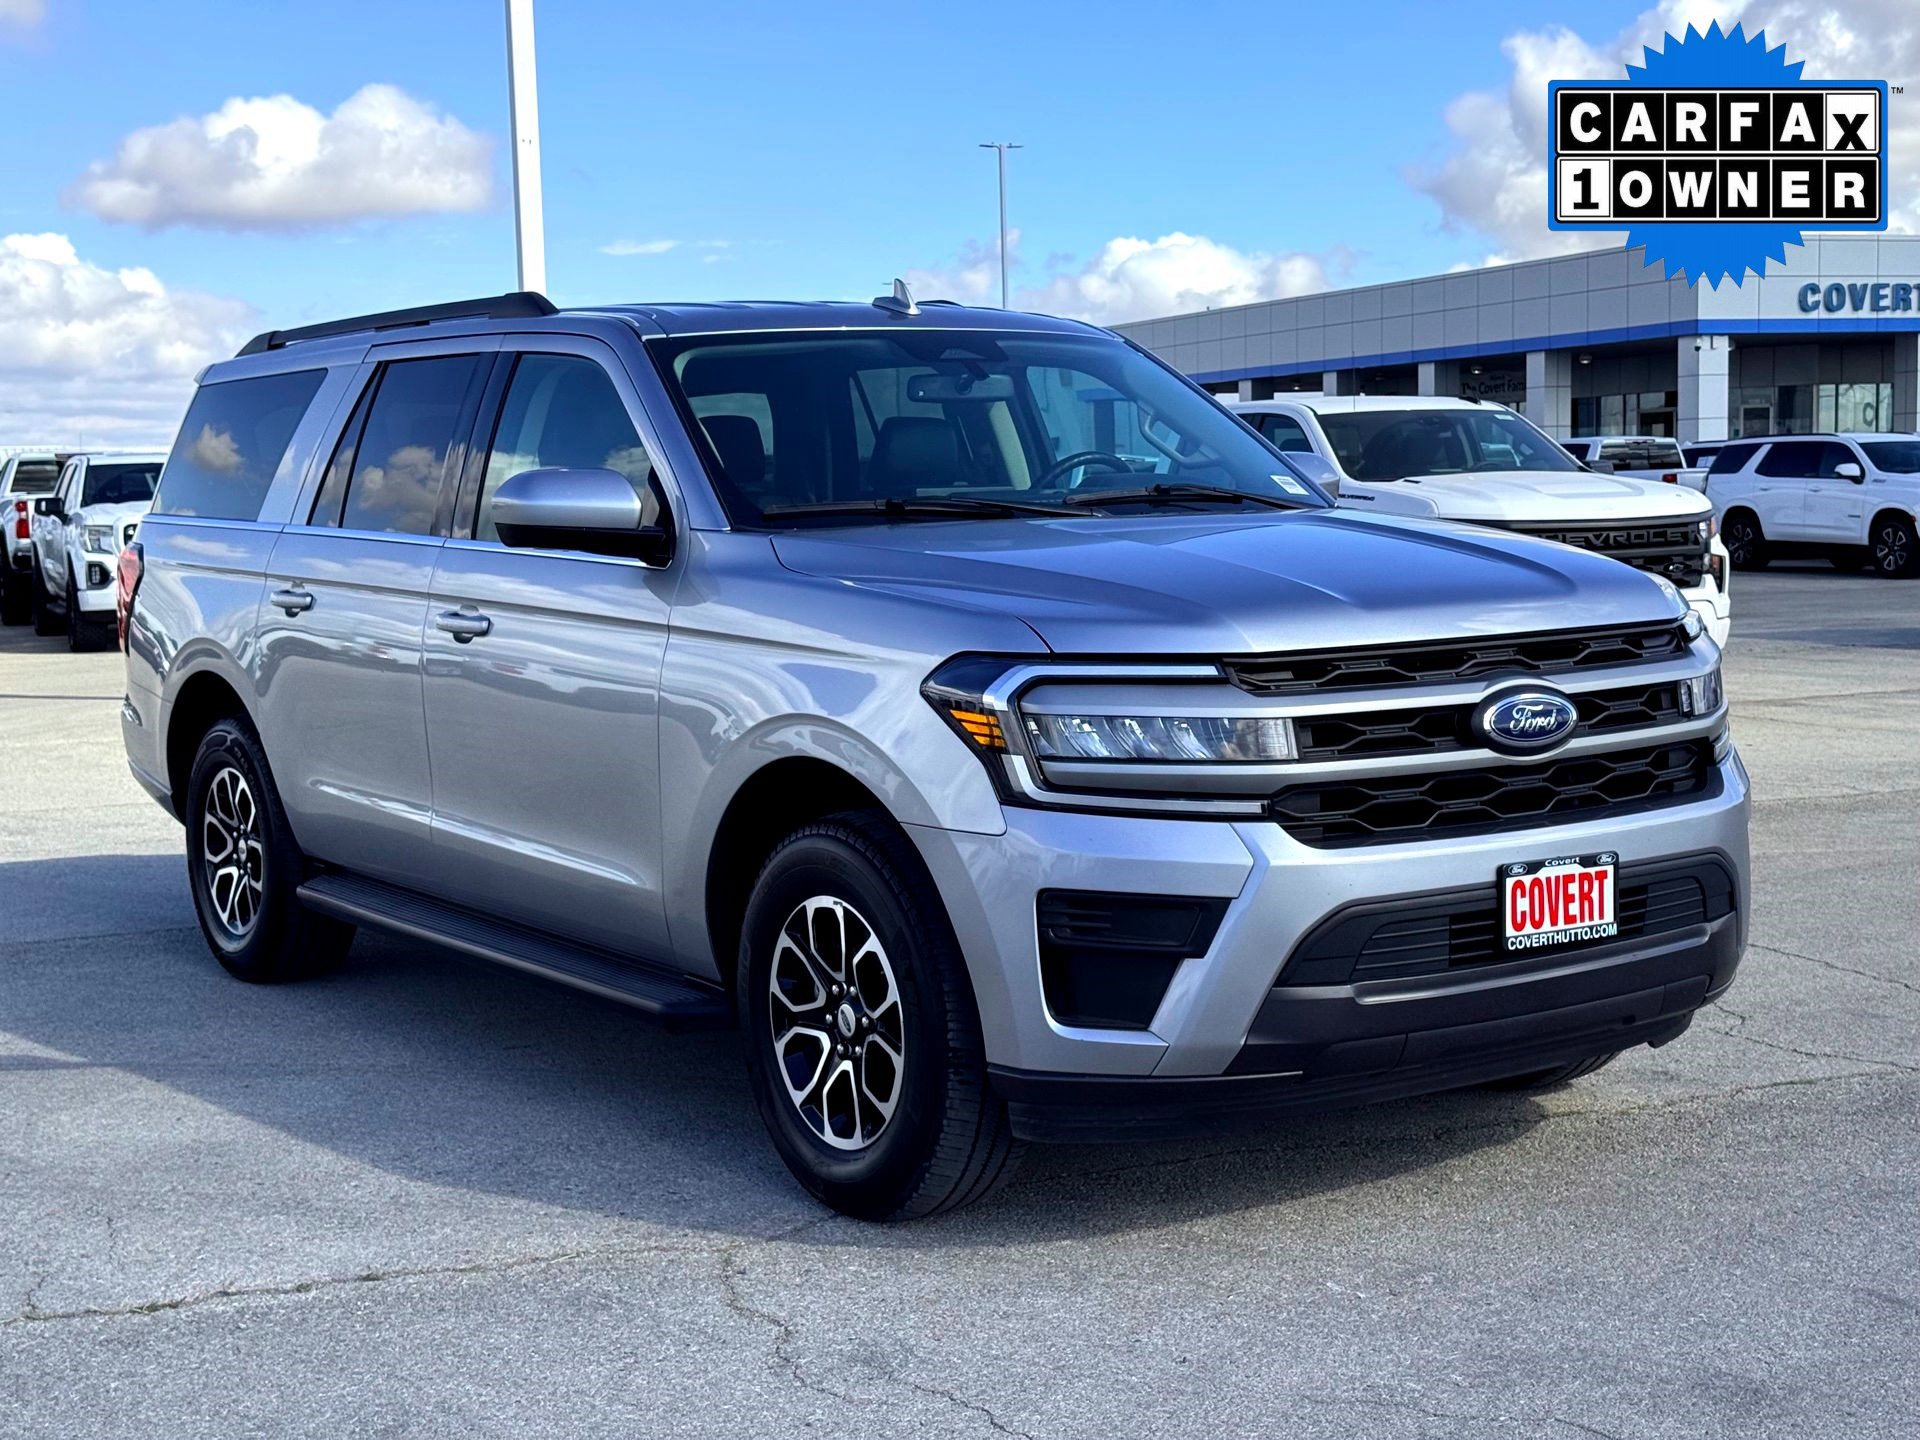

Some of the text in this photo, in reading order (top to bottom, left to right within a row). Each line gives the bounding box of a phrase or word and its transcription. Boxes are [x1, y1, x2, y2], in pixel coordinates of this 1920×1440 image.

[1479, 382, 1506, 395] Covert
[1510, 705, 1558, 732] Ford
[1545, 857, 1580, 866] Covert
[1511, 869, 1608, 932] COVERT
[1507, 923, 1618, 950] COVERTHUTTO.COM
